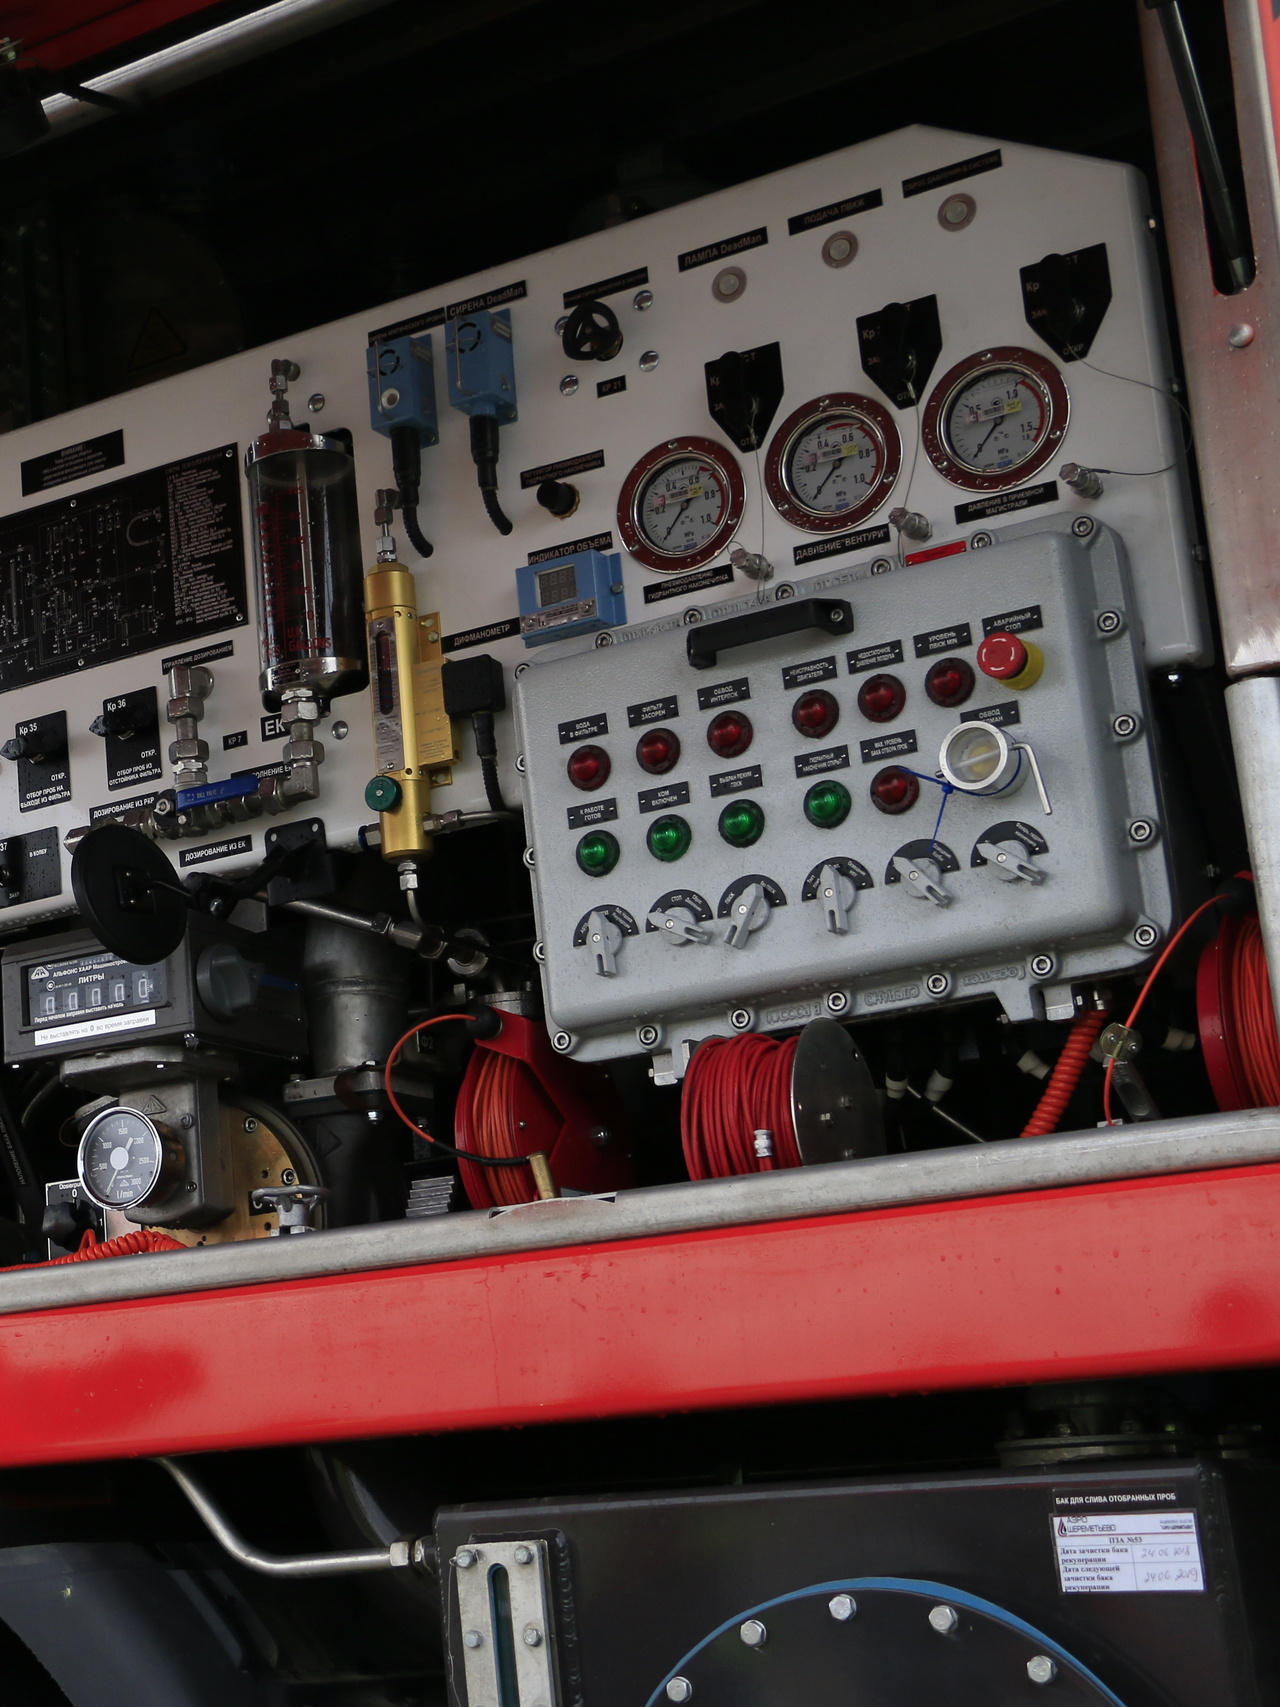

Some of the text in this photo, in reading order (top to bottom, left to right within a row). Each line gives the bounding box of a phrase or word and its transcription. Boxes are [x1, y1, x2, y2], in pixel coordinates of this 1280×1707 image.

[684, 234, 762, 266] ЛАМПА DeadMan
[450, 287, 524, 316] СИРЕНА DeadMan
[1020, 421, 1033, 433] 1.5
[842, 432, 854, 443] 0.6
[817, 439, 829, 450] 0.4
[858, 448, 870, 459] 0.8
[853, 473, 865, 484] 1.0
[704, 489, 716, 500] 0.8
[968, 498, 1002, 512] ДАВЛЕНИЕ
[985, 499, 1029, 514] МАГИСТРАЛИ
[701, 513, 712, 524] 1.0
[528, 536, 612, 564] ИНДИКАТОР ОБЪЕМА
[796, 541, 841, 560] ДАВЛЕНИЕ
[648, 585, 688, 600] ГИДРАНТНОГО
[993, 612, 1032, 628] АВАРИЙНЫЙ
[1005, 622, 1022, 632] СТОП
[454, 624, 510, 647] ДИФМАНОМЕТР
[928, 631, 957, 642] УРОВЕНЬ
[946, 637, 958, 646] MIN
[163, 644, 233, 669] УПРАВЛЕНИЕ ДОЗИРОВАНИЕМ
[790, 661, 829, 676] НЕИСПРАВНОСТЬ
[107, 699, 126, 713] Кр 36
[641, 709, 666, 721] ЗАСОРЕН
[979, 708, 1001, 719] ОБВОД
[19, 722, 38, 736] Кр 35
[264, 719, 286, 737] ЕК
[574, 726, 598, 737] ФИЛЬТРЕ
[575, 721, 591, 730] ВОДА
[228, 735, 242, 746] КР 7
[109, 767, 162, 786] ОТСТОЙНИКА ФИЛЬТРА
[116, 767, 133, 777] ОТБОР
[132, 764, 145, 773] ПРОБ
[26, 790, 42, 800] ОТБОР
[43, 786, 56, 796] ПРОБ
[657, 790, 670, 798] КОМ
[20, 797, 41, 809] ВЫХОДЕ
[48, 790, 71, 801] ФИЛЬТРА
[651, 795, 678, 807] ВКЛЮЧЕН
[93, 802, 134, 819] ДОЗИРОВАНИЕ
[135, 798, 143, 808] ИЗ
[584, 804, 605, 815] РАБОТЕ
[584, 812, 602, 821] ГОТОВ
[0, 842, 8, 852] 37
[185, 840, 246, 862] ДОЗИРОВАНИЕ ИЗ ЕК
[52, 967, 78, 978] АЛЬФОНС
[78, 964, 93, 973] ХААР
[78, 973, 105, 985] ЛИТРЫ
[34, 1015, 48, 1024] Перед
[48, 1013, 66, 1022] началом
[66, 1009, 85, 1019] заправки
[85, 1005, 107, 1014] выставить
[40, 1032, 50, 1041] Не
[50, 1028, 80, 1040] выставлять
[89, 1024, 95, 1032] 0
[105, 1021, 122, 1031] время
[123, 1016, 150, 1026] заправки
[117, 1127, 128, 1135] 1500
[99, 1162, 107, 1170] 500
[139, 1156, 149, 1164] 2500
[131, 1178, 141, 1186] 3000
[71, 1188, 78, 1198] 0
[99, 1218, 103, 1226] 1
[1056, 1492, 1176, 1505] БАК ДЛЯ СЛИВА ОТОБРАННЫХ ПРОБ
[1067, 1524, 1117, 1533] ШЕРЕМЕТЬЕВО
[1061, 1557, 1107, 1565] рекуперации
[1080, 1565, 1120, 1573] следующей
[1064, 1584, 1110, 1592] рекуперации
